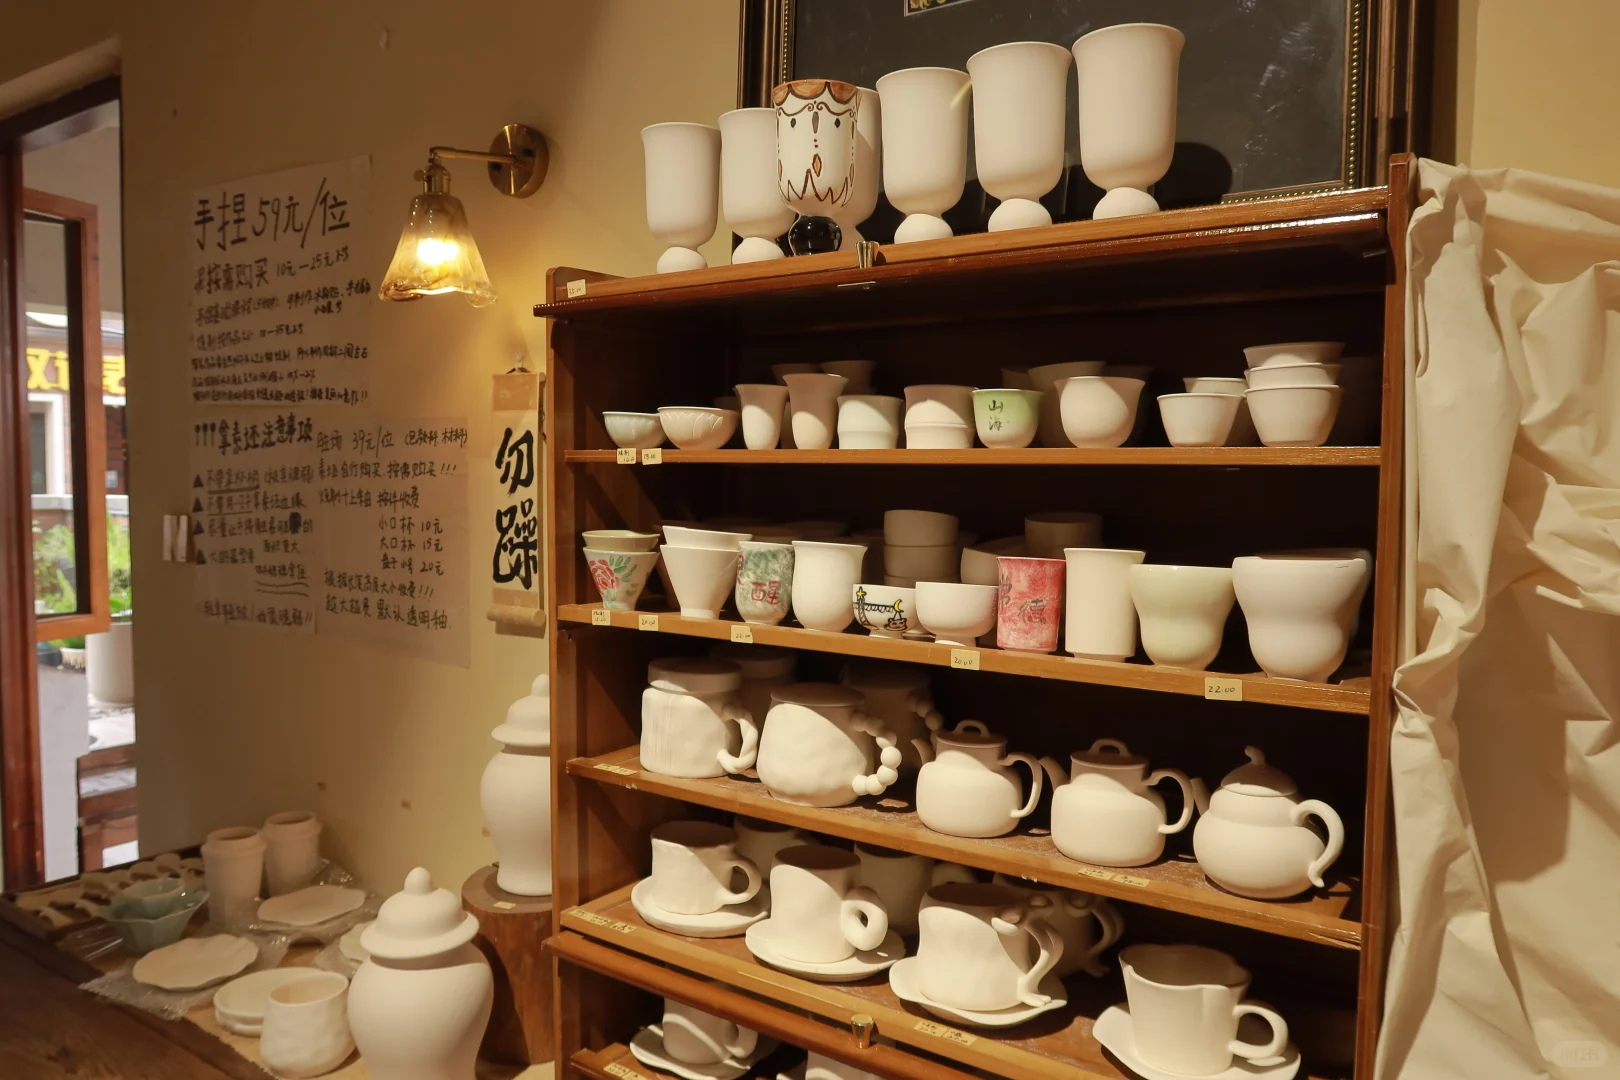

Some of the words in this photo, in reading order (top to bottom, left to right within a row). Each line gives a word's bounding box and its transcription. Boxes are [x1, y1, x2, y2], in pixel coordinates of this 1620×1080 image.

[194, 177, 350, 251] 手捏59元/位
[352, 425, 395, 458] 39元/位
[379, 514, 415, 535] 小口杯
[421, 518, 443, 534] 10元
[379, 536, 416, 552] 大口杯
[422, 538, 443, 552] 15元
[420, 561, 444, 576] 20元
[1208, 685, 1236, 694] 22.00
